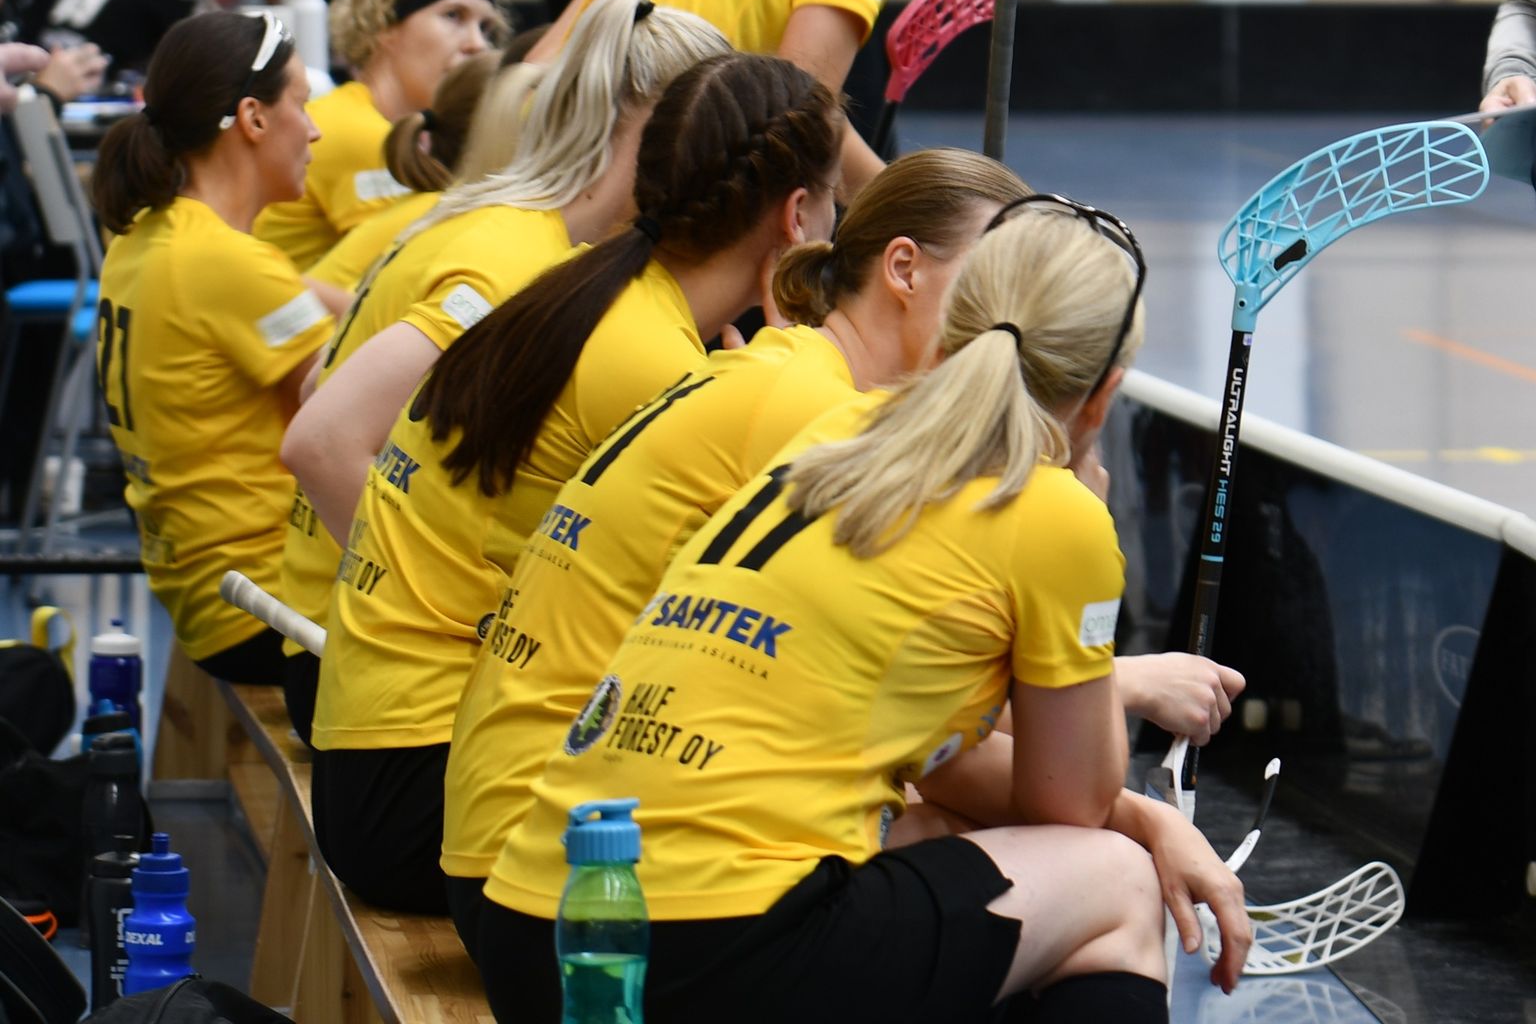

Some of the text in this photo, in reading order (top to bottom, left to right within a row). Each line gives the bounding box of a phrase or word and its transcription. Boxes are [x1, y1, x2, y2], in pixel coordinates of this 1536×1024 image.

[1210, 367, 1244, 543] ULTRALIGHT HES 29
[652, 594, 793, 659] SAHTEK
[623, 682, 676, 718] HALF
[606, 716, 724, 771] FOREST OY
